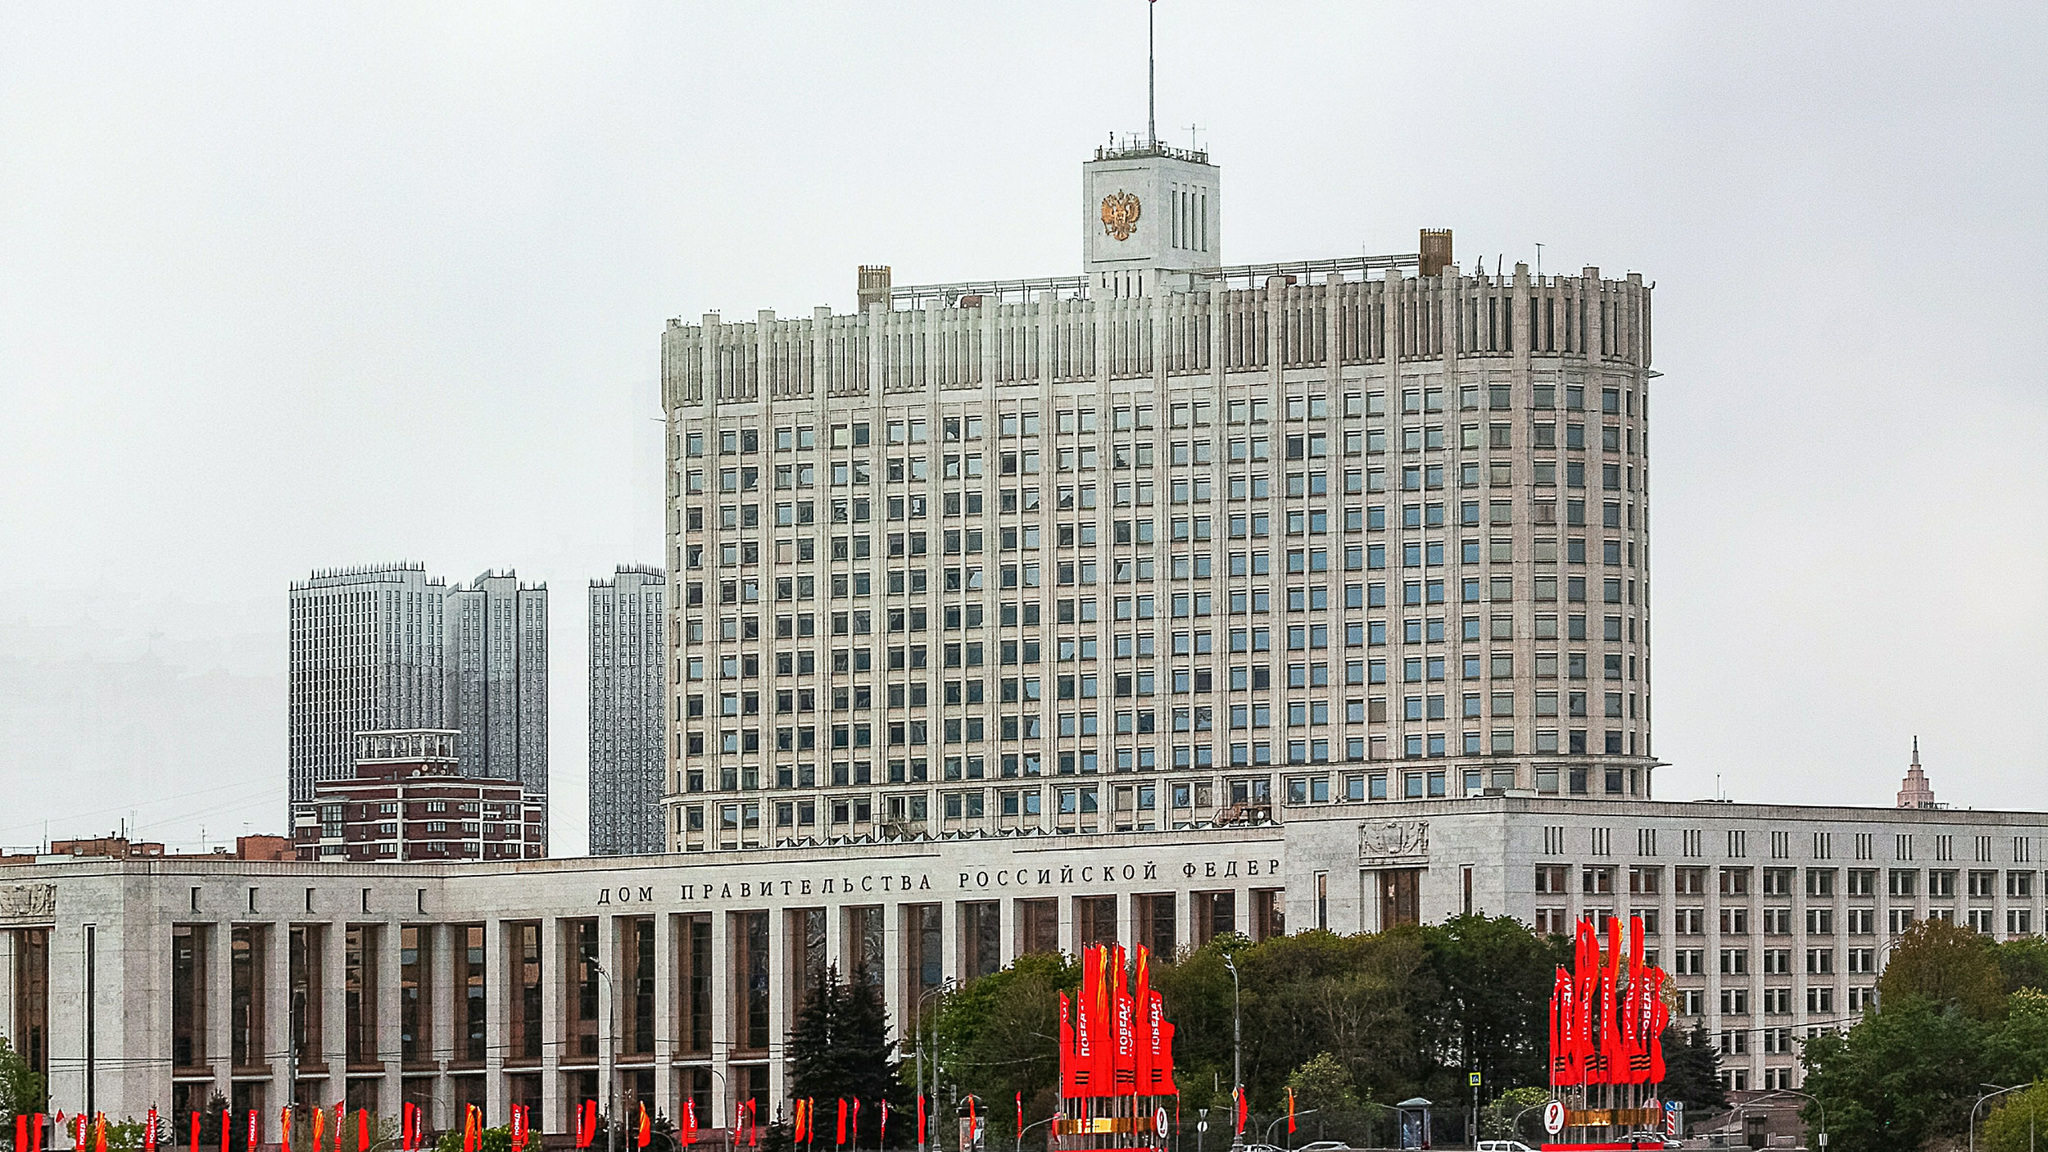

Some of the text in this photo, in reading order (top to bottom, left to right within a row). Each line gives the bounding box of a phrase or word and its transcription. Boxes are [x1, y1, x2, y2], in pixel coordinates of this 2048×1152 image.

[598, 859, 1280, 905] ДОМ ПРАВИТЕЛЬСТВА РОССИЙСКОЙ ФЕДЕР
[1119, 997, 1128, 1055] ПОБЕДА!
[1550, 1105, 1558, 1124] 9
